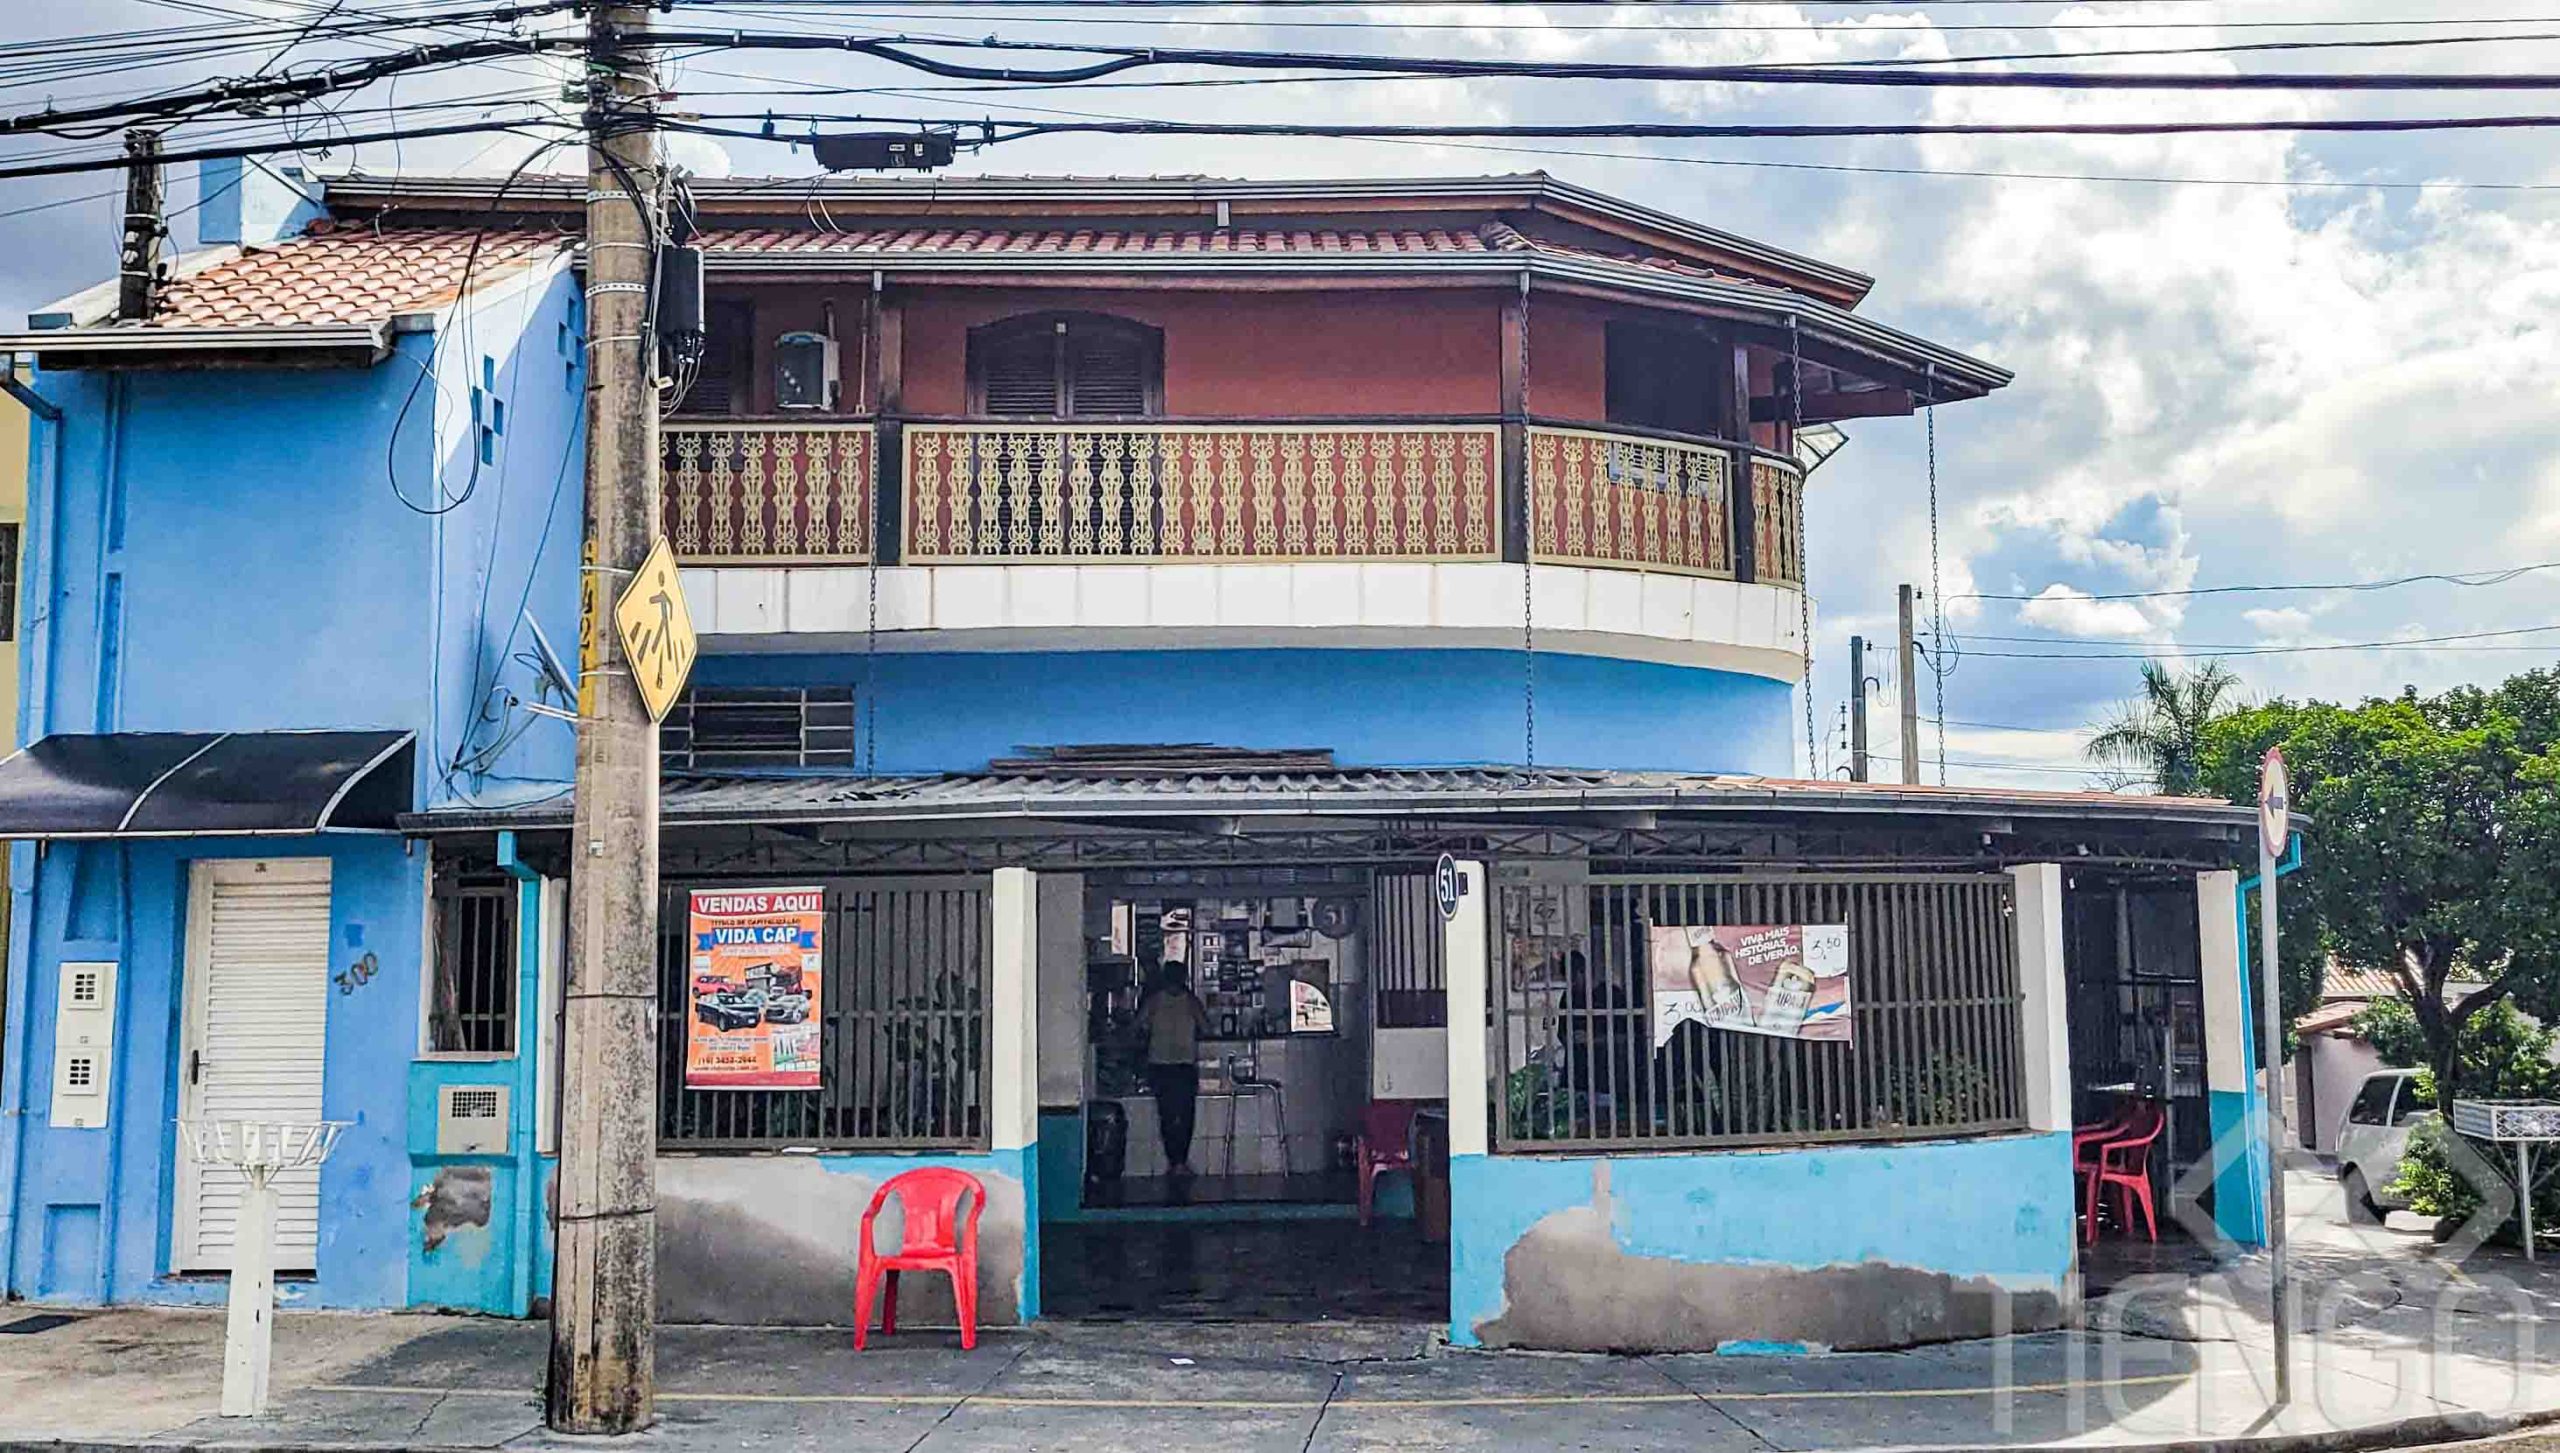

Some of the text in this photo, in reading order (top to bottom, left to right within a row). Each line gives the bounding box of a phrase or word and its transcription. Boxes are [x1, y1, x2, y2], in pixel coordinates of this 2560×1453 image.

[1440, 867, 1456, 902] 51
[697, 893, 818, 914] VENDAS AQUI
[715, 926, 798, 944] VIDA CAP
[1740, 926, 1790, 946] VIVA MAIS
[1748, 955, 1763, 966] DE
[334, 952, 378, 996] 300
